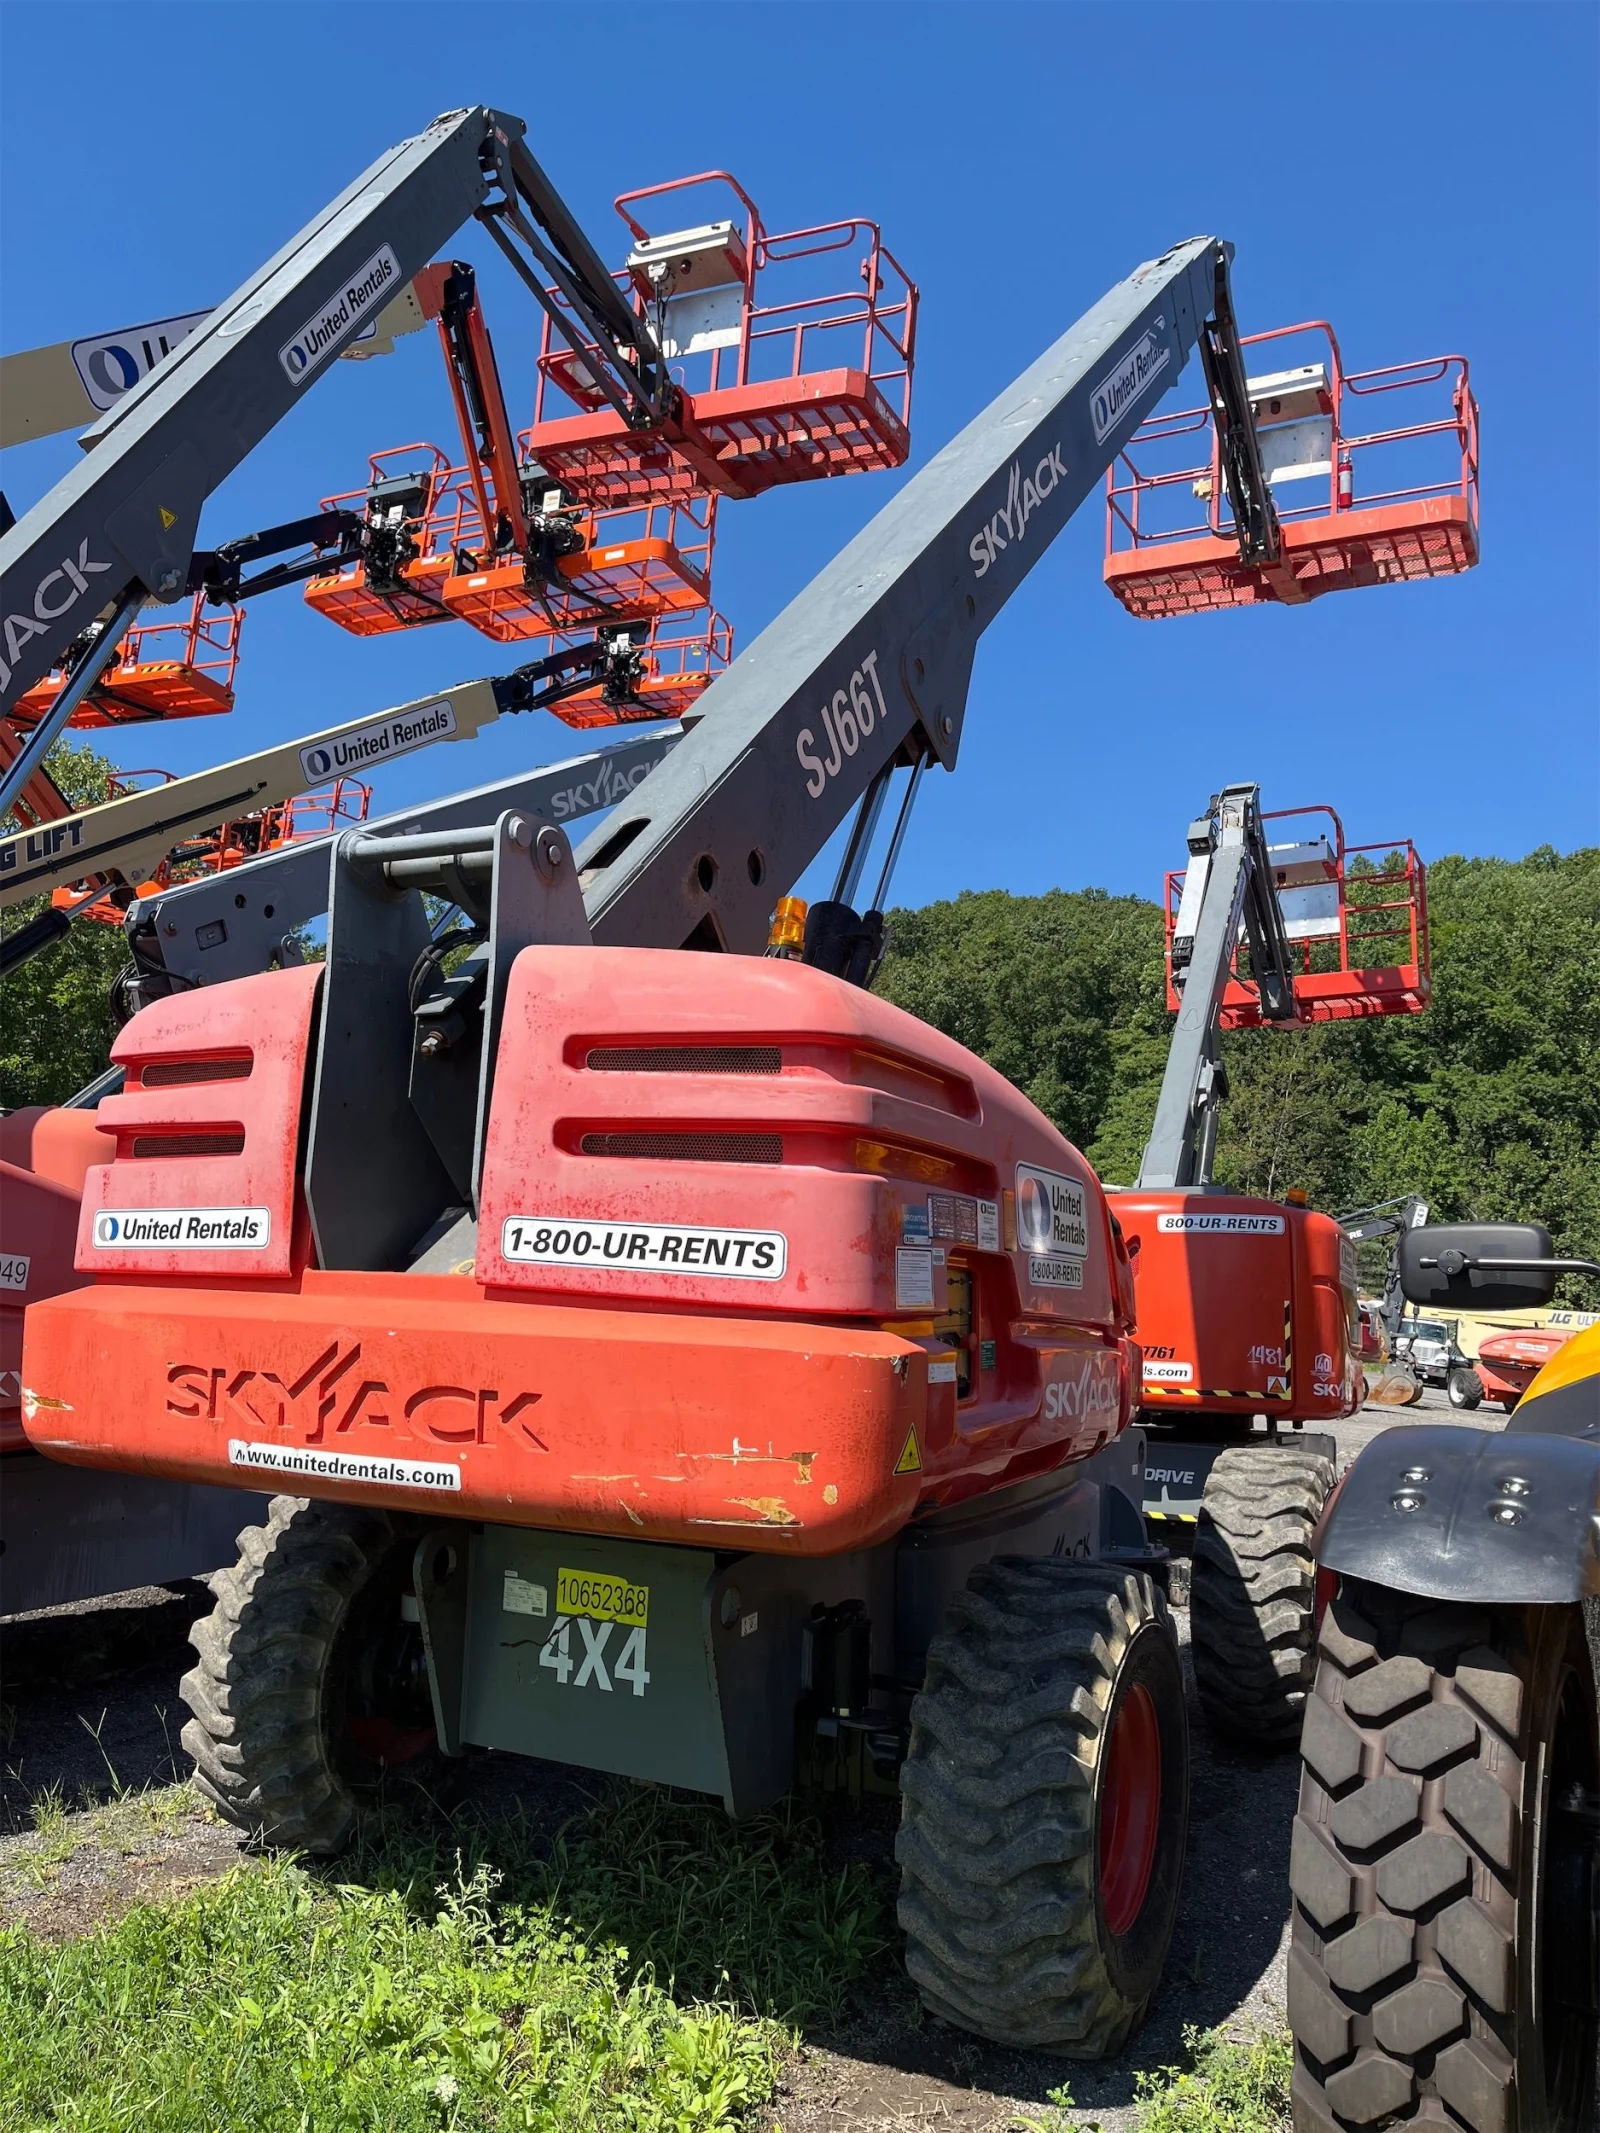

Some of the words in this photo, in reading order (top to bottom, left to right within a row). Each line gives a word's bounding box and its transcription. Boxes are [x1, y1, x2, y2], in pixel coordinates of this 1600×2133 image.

[304, 299, 350, 355] United
[346, 259, 393, 313] Rentals
[1108, 361, 1137, 415] United
[969, 441, 1068, 578] SKYJACK
[333, 728, 390, 766] United
[392, 710, 448, 745] Rentals
[797, 649, 887, 798] SJ66T
[27, 819, 83, 862] LIFT
[1052, 1184, 1082, 1217] United
[123, 1217, 183, 1240] United
[186, 1216, 258, 1239] Rentals
[1053, 1215, 1085, 1246] Rentals
[1165, 1217, 1278, 1230] 800-UR-RENTS
[510, 1227, 776, 1269] 1-800-UR-RENTS
[0, 1261, 26, 1284] 49
[1031, 1261, 1080, 1282] 1-800-UR-RENTS
[1548, 1313, 1572, 1324] JLG
[1142, 1346, 1175, 1359] 7761
[1143, 1366, 1188, 1377] ls.com
[167, 1341, 549, 1453] SKYJACK
[1045, 1360, 1116, 1424] SKYJACK
[1144, 1468, 1195, 1484] DRIVE
[560, 1577, 646, 1617] 10652368
[539, 1616, 650, 1697] 4X4
